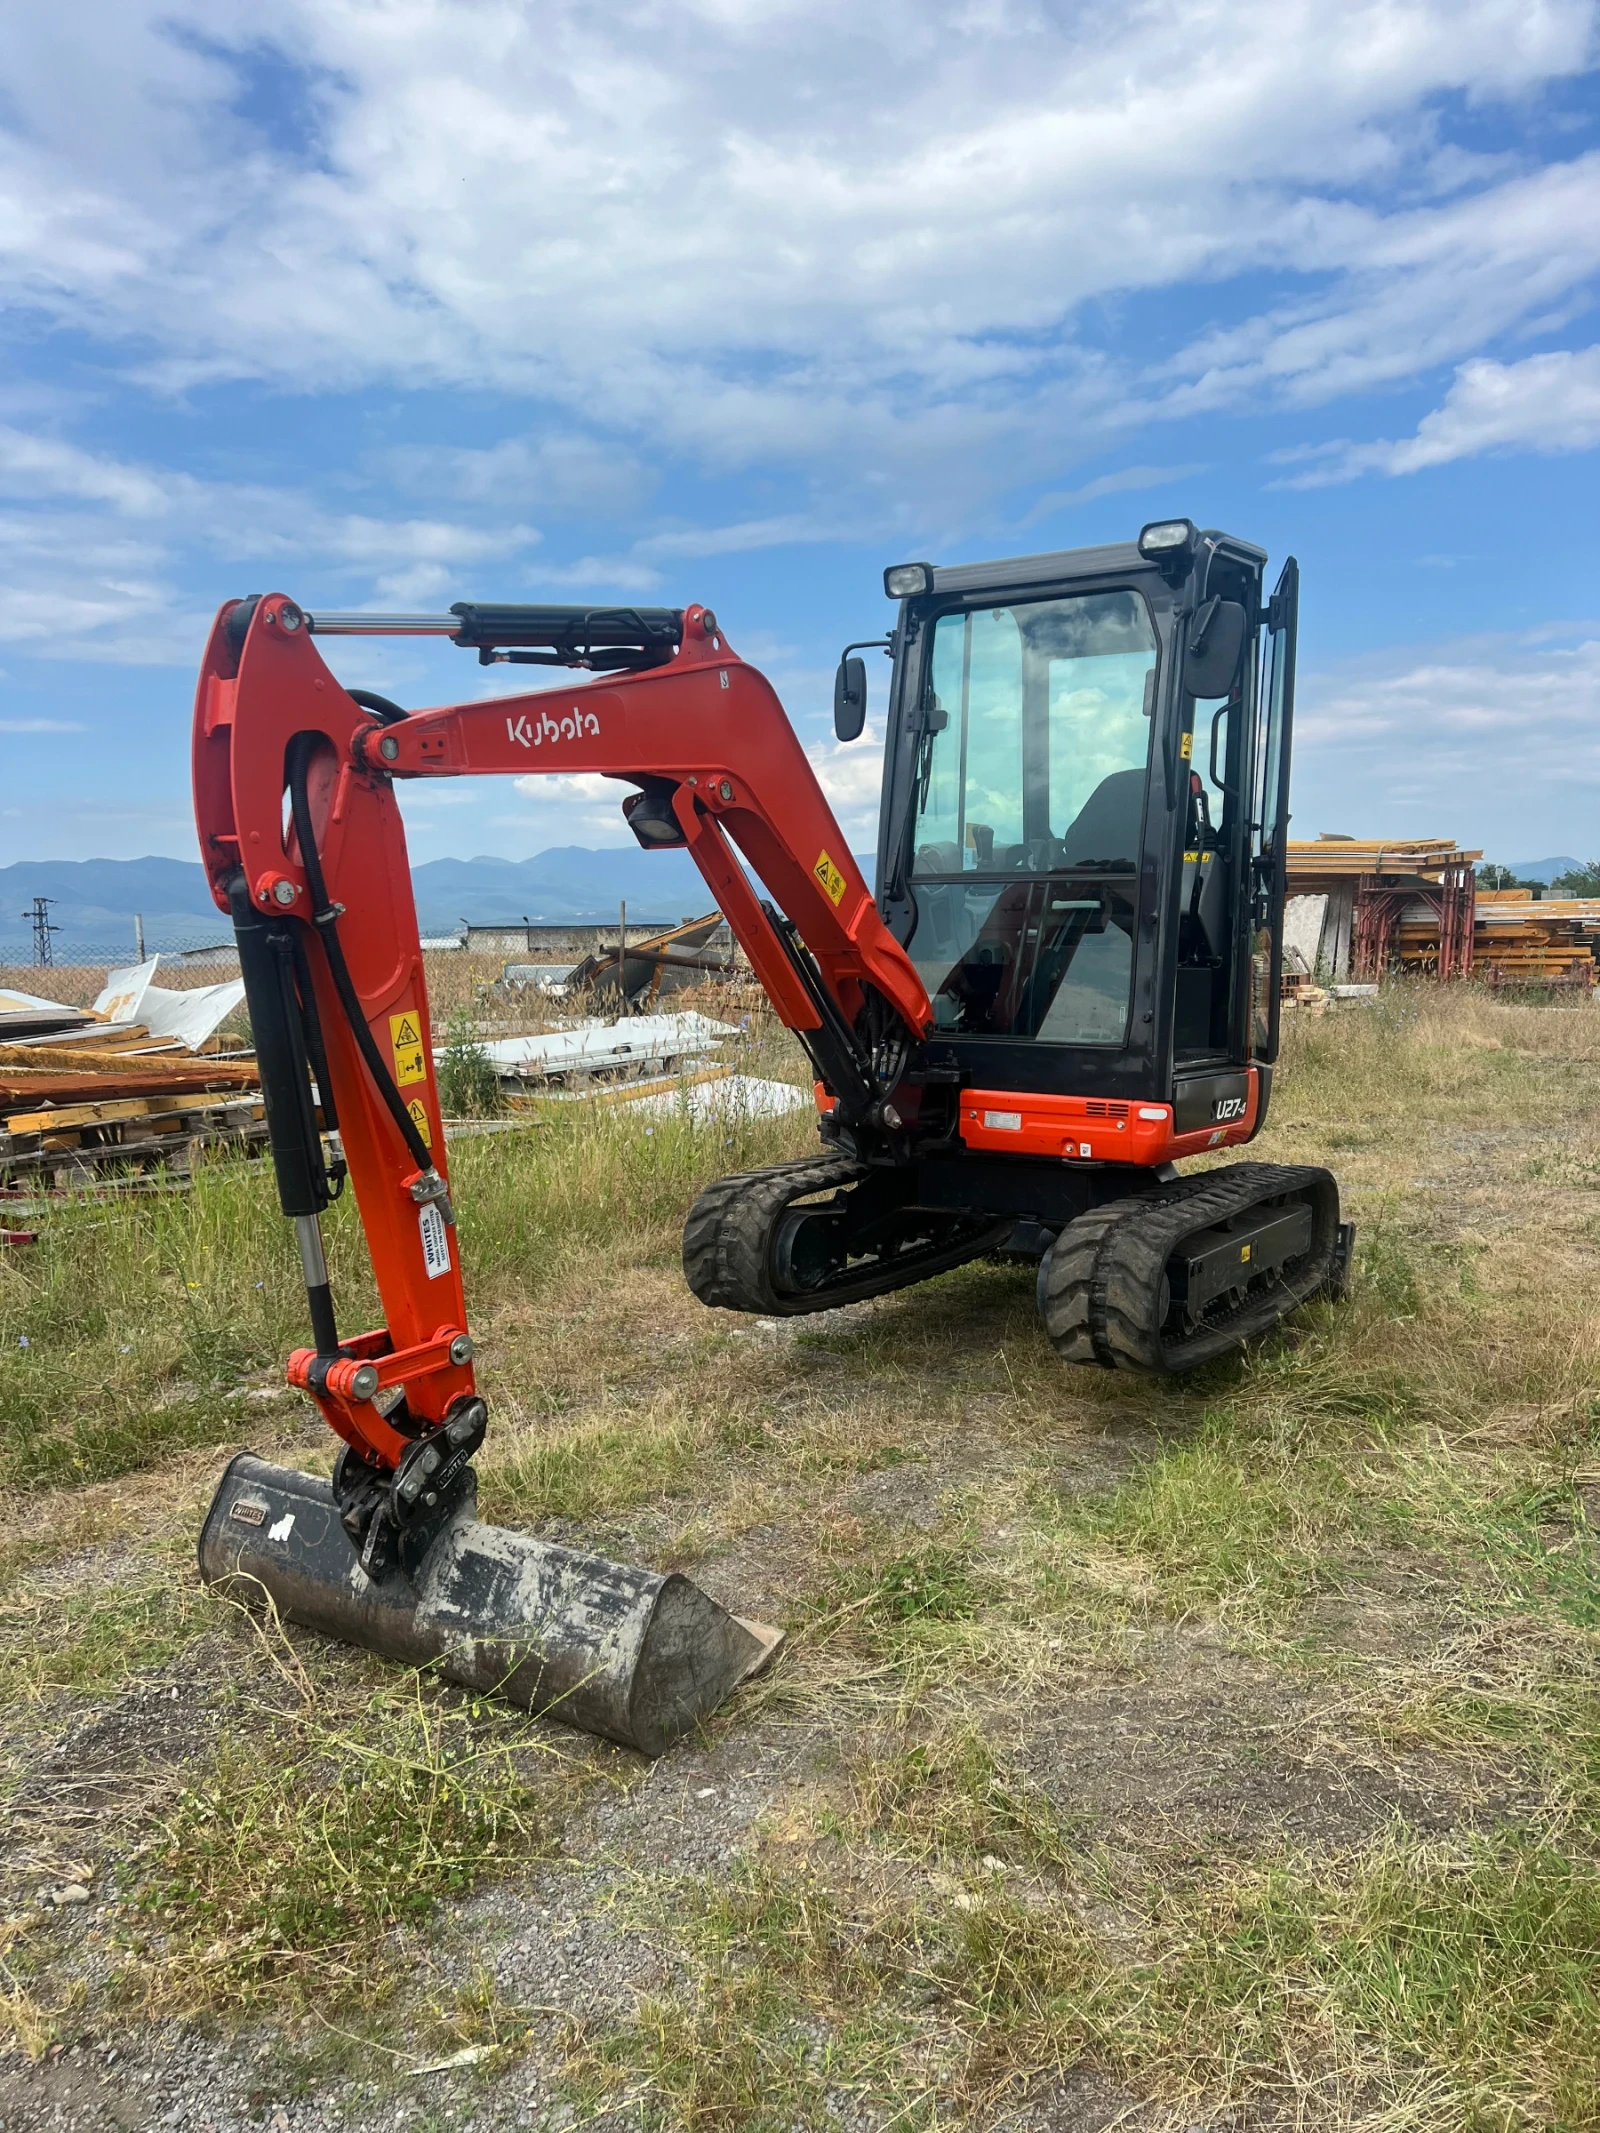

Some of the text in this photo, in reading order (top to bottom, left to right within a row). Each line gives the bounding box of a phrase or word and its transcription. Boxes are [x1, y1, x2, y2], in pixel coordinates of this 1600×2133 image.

[506, 707, 600, 748] Kubota
[1216, 1098, 1246, 1119] U27-4
[423, 1219, 435, 1264] WHITES
[235, 1506, 262, 1521] WHITES
